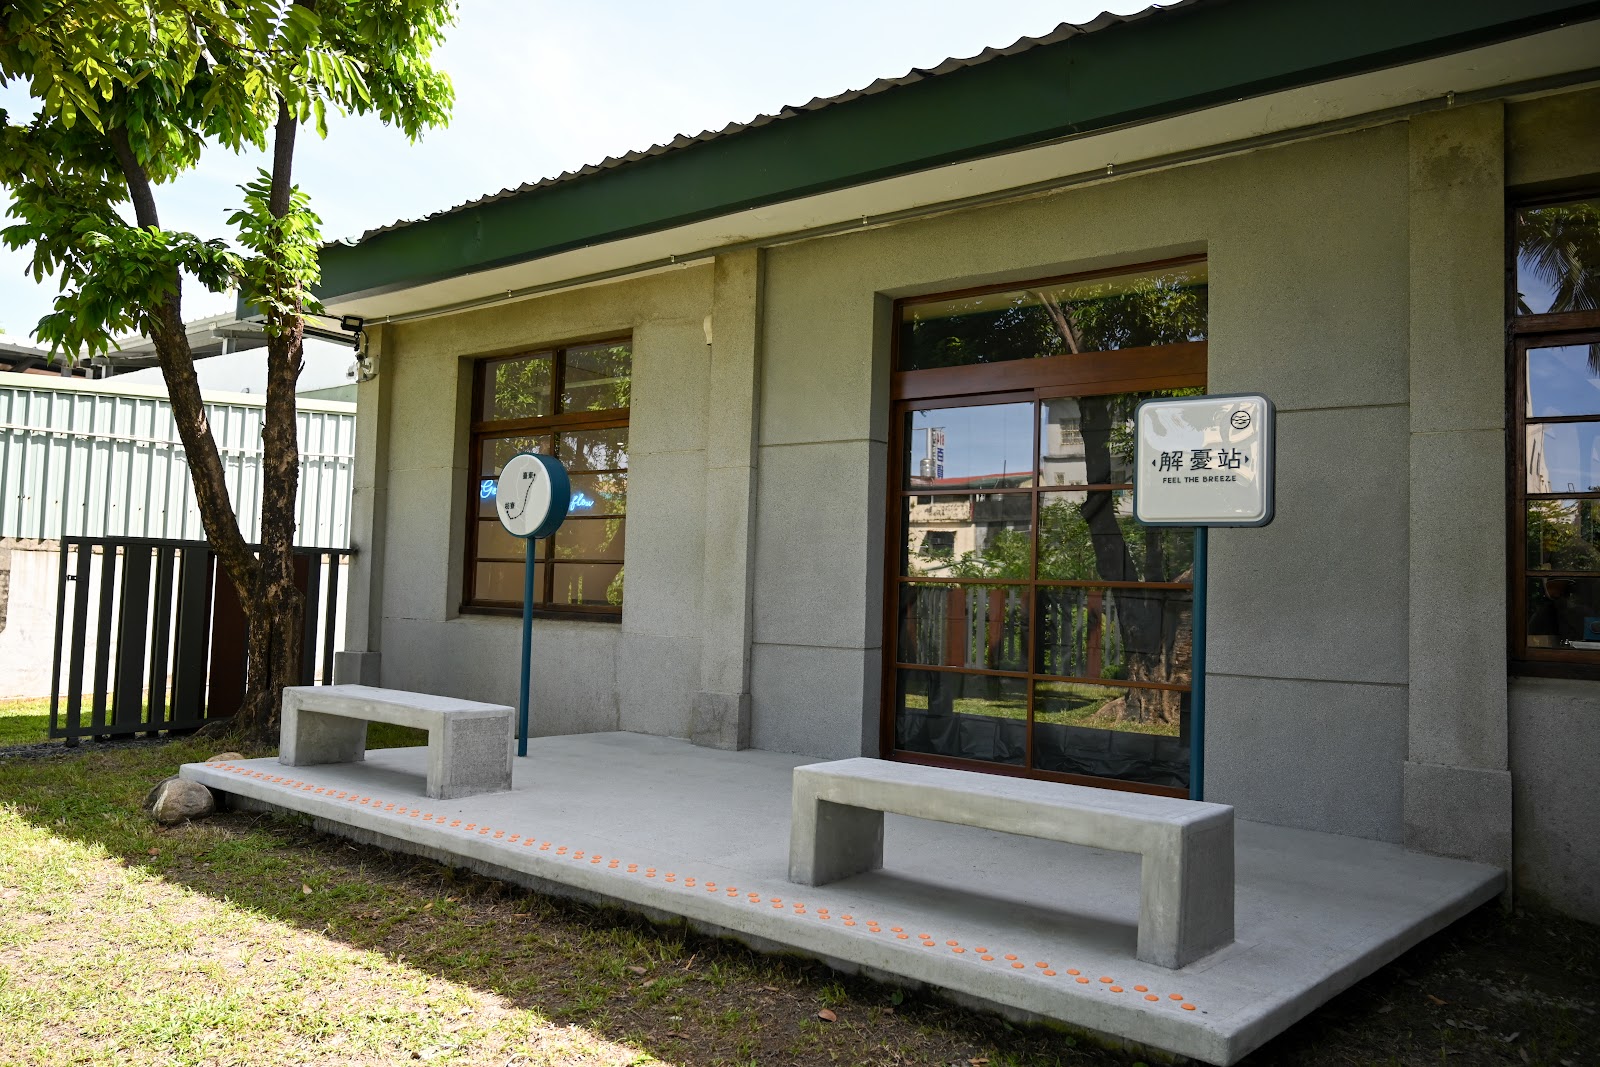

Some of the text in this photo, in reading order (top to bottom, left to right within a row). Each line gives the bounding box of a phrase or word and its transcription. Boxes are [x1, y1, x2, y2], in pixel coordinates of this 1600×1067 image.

[1158, 447, 1242, 472] 解憂站
[1202, 475, 1237, 483] BREEZE
[569, 492, 595, 511] flow
